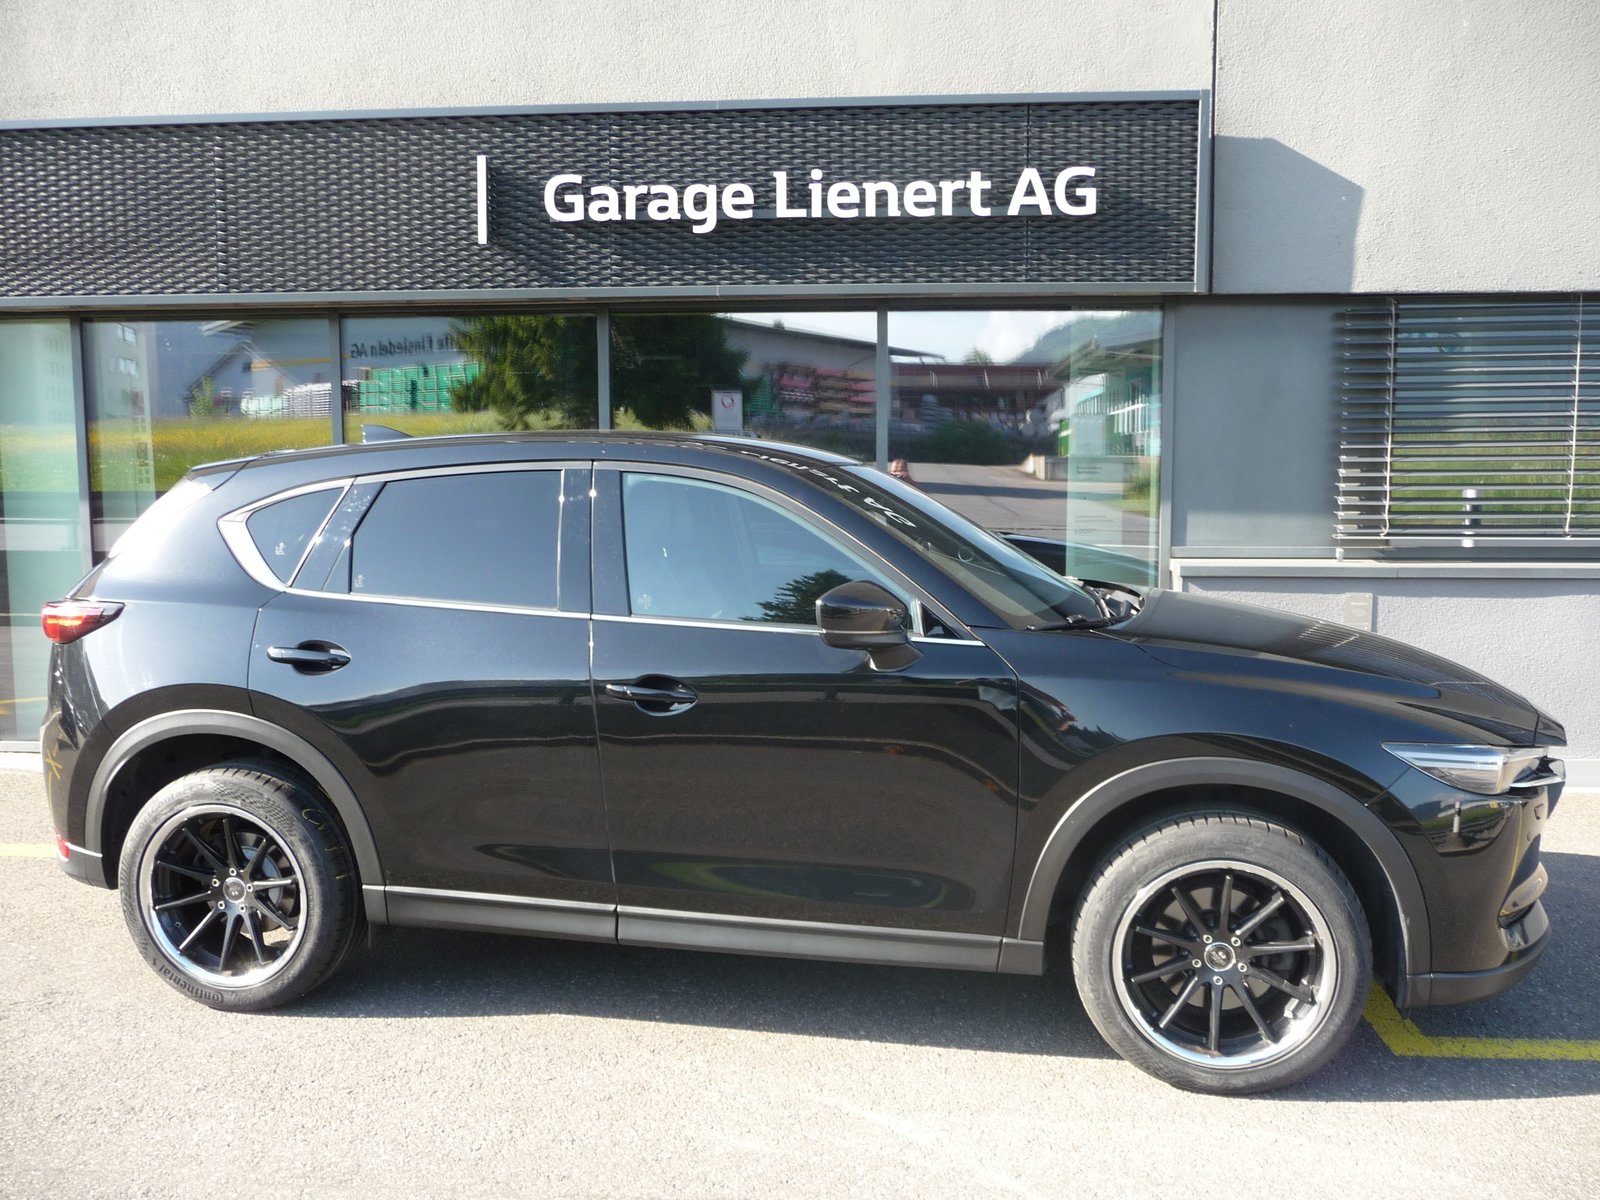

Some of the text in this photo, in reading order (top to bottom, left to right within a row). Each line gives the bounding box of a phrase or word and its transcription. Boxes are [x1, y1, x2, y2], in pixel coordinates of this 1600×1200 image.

[543, 166, 1098, 234] Garage Lienert AG
[158, 964, 225, 1004] Continental
